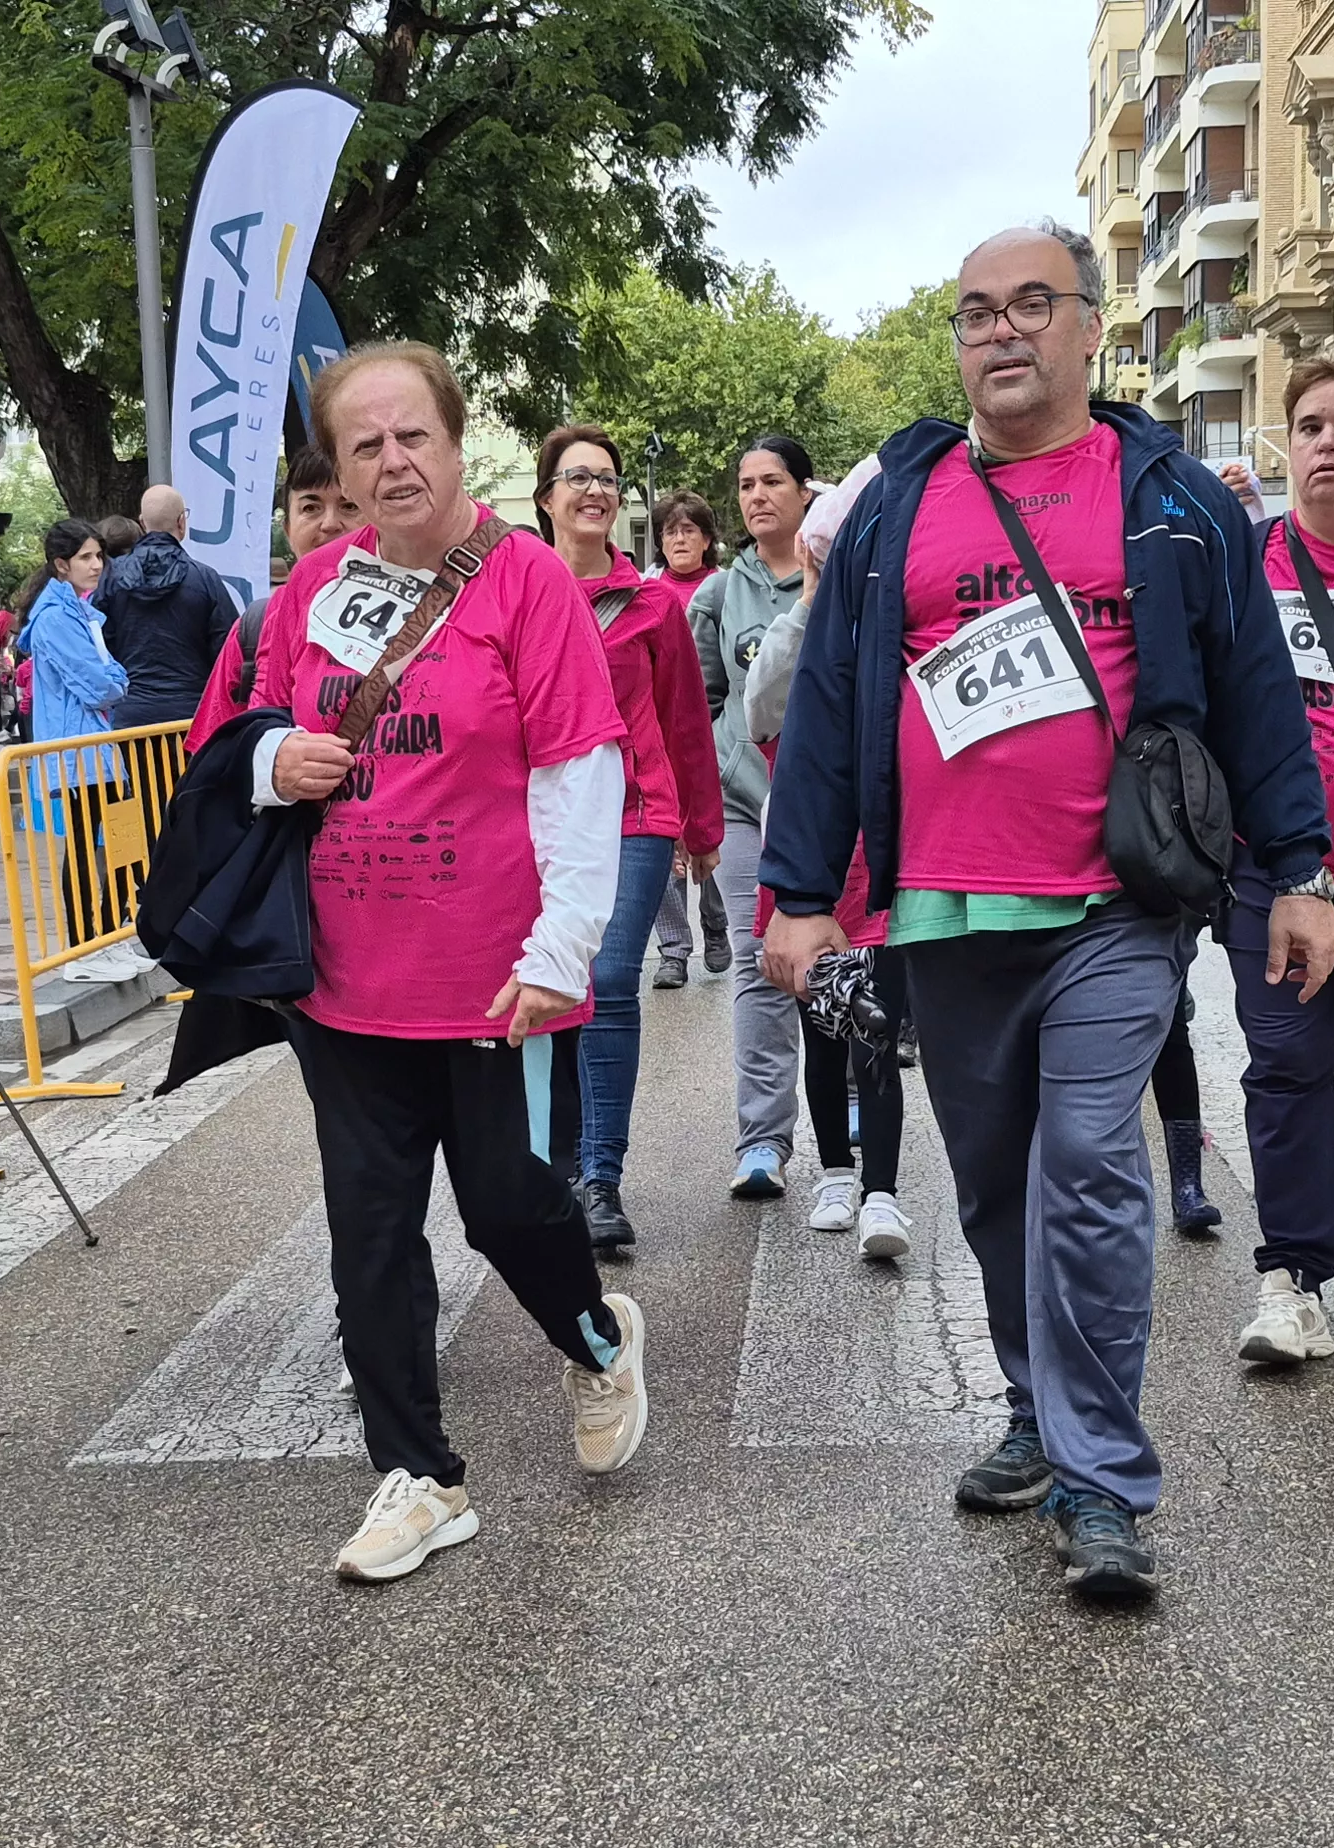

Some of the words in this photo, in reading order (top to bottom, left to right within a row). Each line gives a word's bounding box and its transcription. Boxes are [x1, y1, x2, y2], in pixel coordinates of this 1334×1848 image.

[388, 581, 402, 595] EL
[338, 592, 415, 646] 64
[968, 621, 1008, 647] HUESCA
[934, 644, 985, 682] CONTRA
[984, 635, 1002, 650] EL
[955, 636, 1056, 708] 641
[381, 713, 444, 755] CADA
